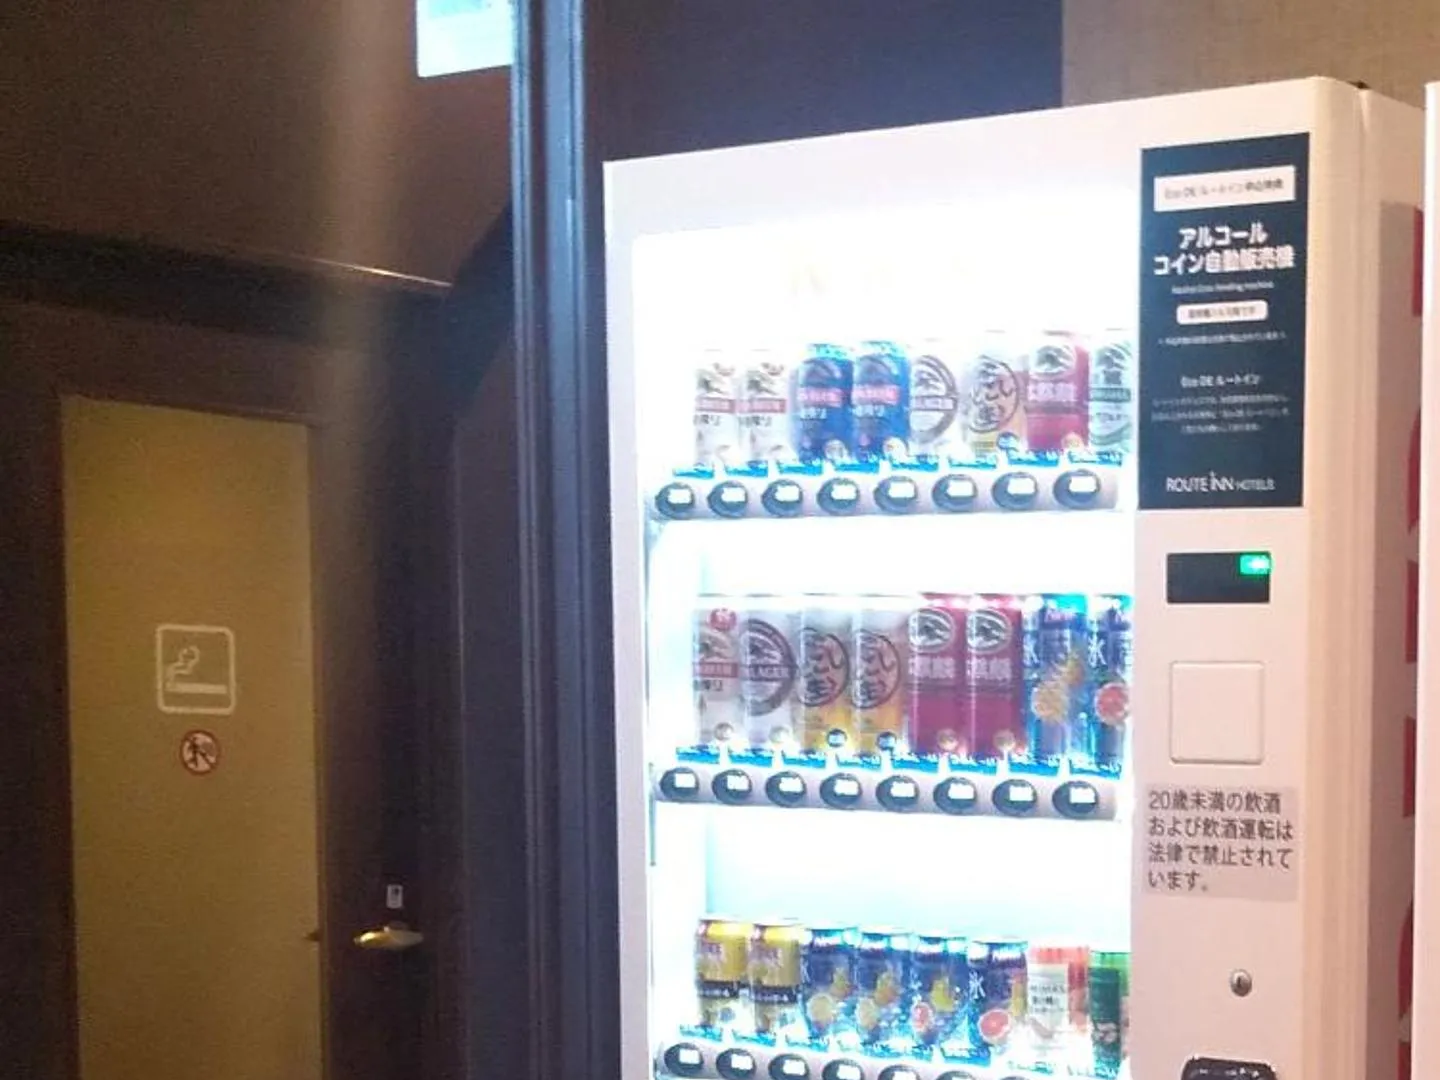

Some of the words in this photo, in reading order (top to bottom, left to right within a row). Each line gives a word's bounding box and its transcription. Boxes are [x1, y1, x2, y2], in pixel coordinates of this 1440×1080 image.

[1179, 222, 1268, 249] アルコール
[1166, 477, 1208, 492] ROUTE
[1148, 789, 1281, 814] 20歳未満の飲酒
[1148, 816, 1294, 841] および飲酒運転は
[1148, 842, 1294, 869] 法律で禁止されて
[1148, 870, 1208, 892] います。
